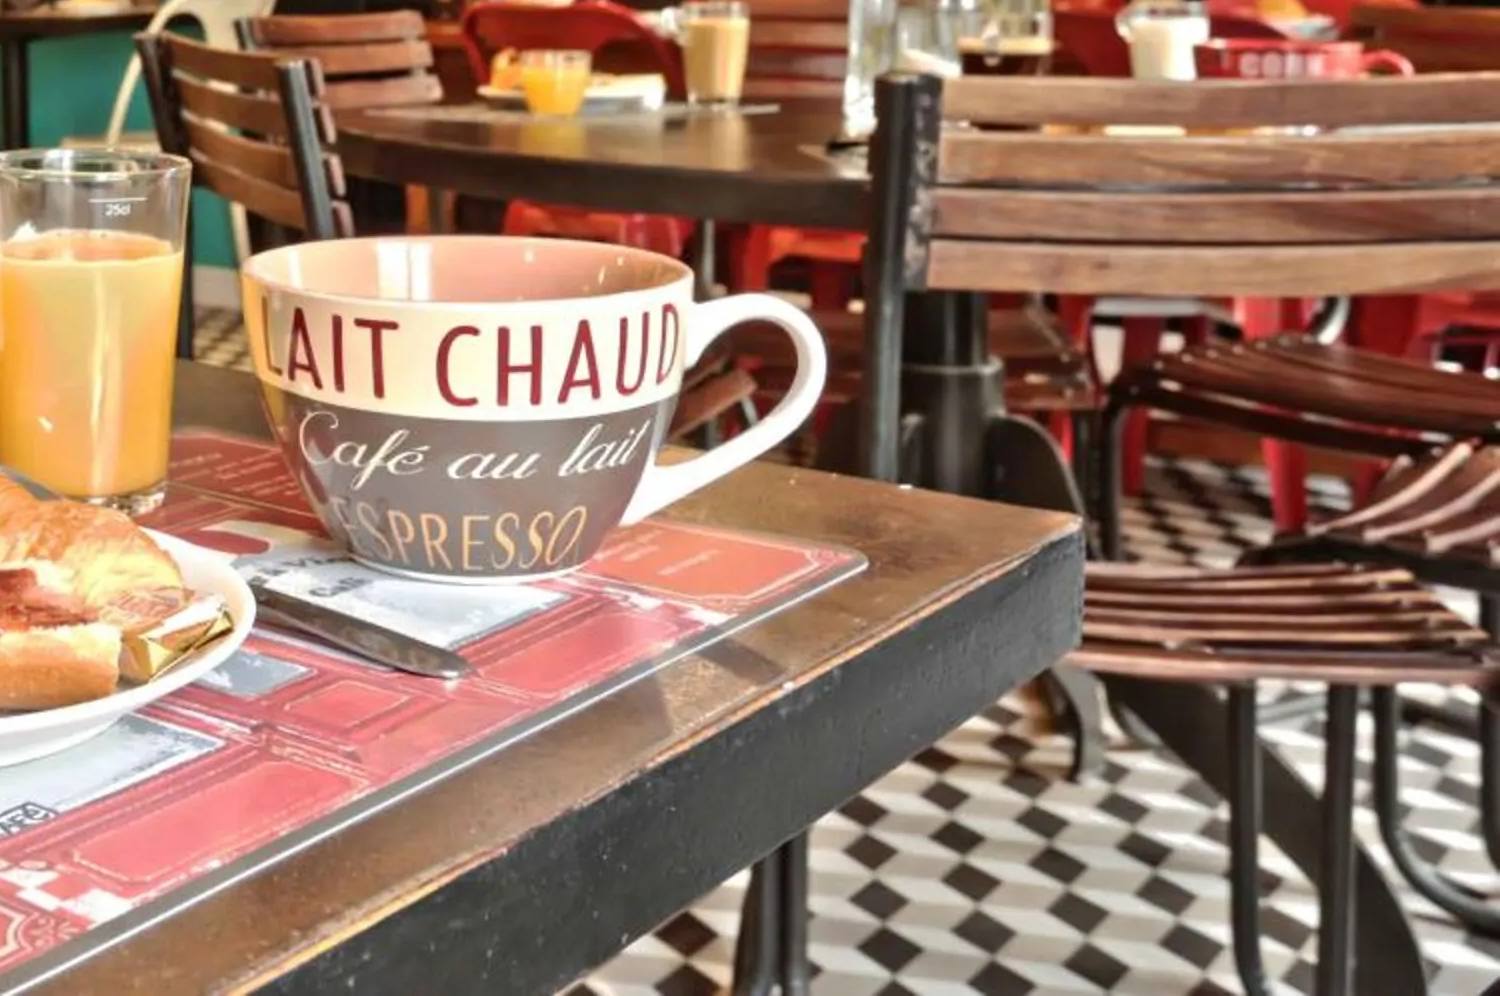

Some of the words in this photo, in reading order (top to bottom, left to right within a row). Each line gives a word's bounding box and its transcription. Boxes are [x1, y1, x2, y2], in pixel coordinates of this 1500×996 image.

[105, 203, 131, 217] 25cl
[261, 295, 399, 399] LAIT
[436, 303, 680, 407] CHAUD
[299, 410, 431, 490] Café
[446, 451, 542, 480] au
[556, 420, 651, 477] lait
[329, 496, 587, 571] ESPRESSO
